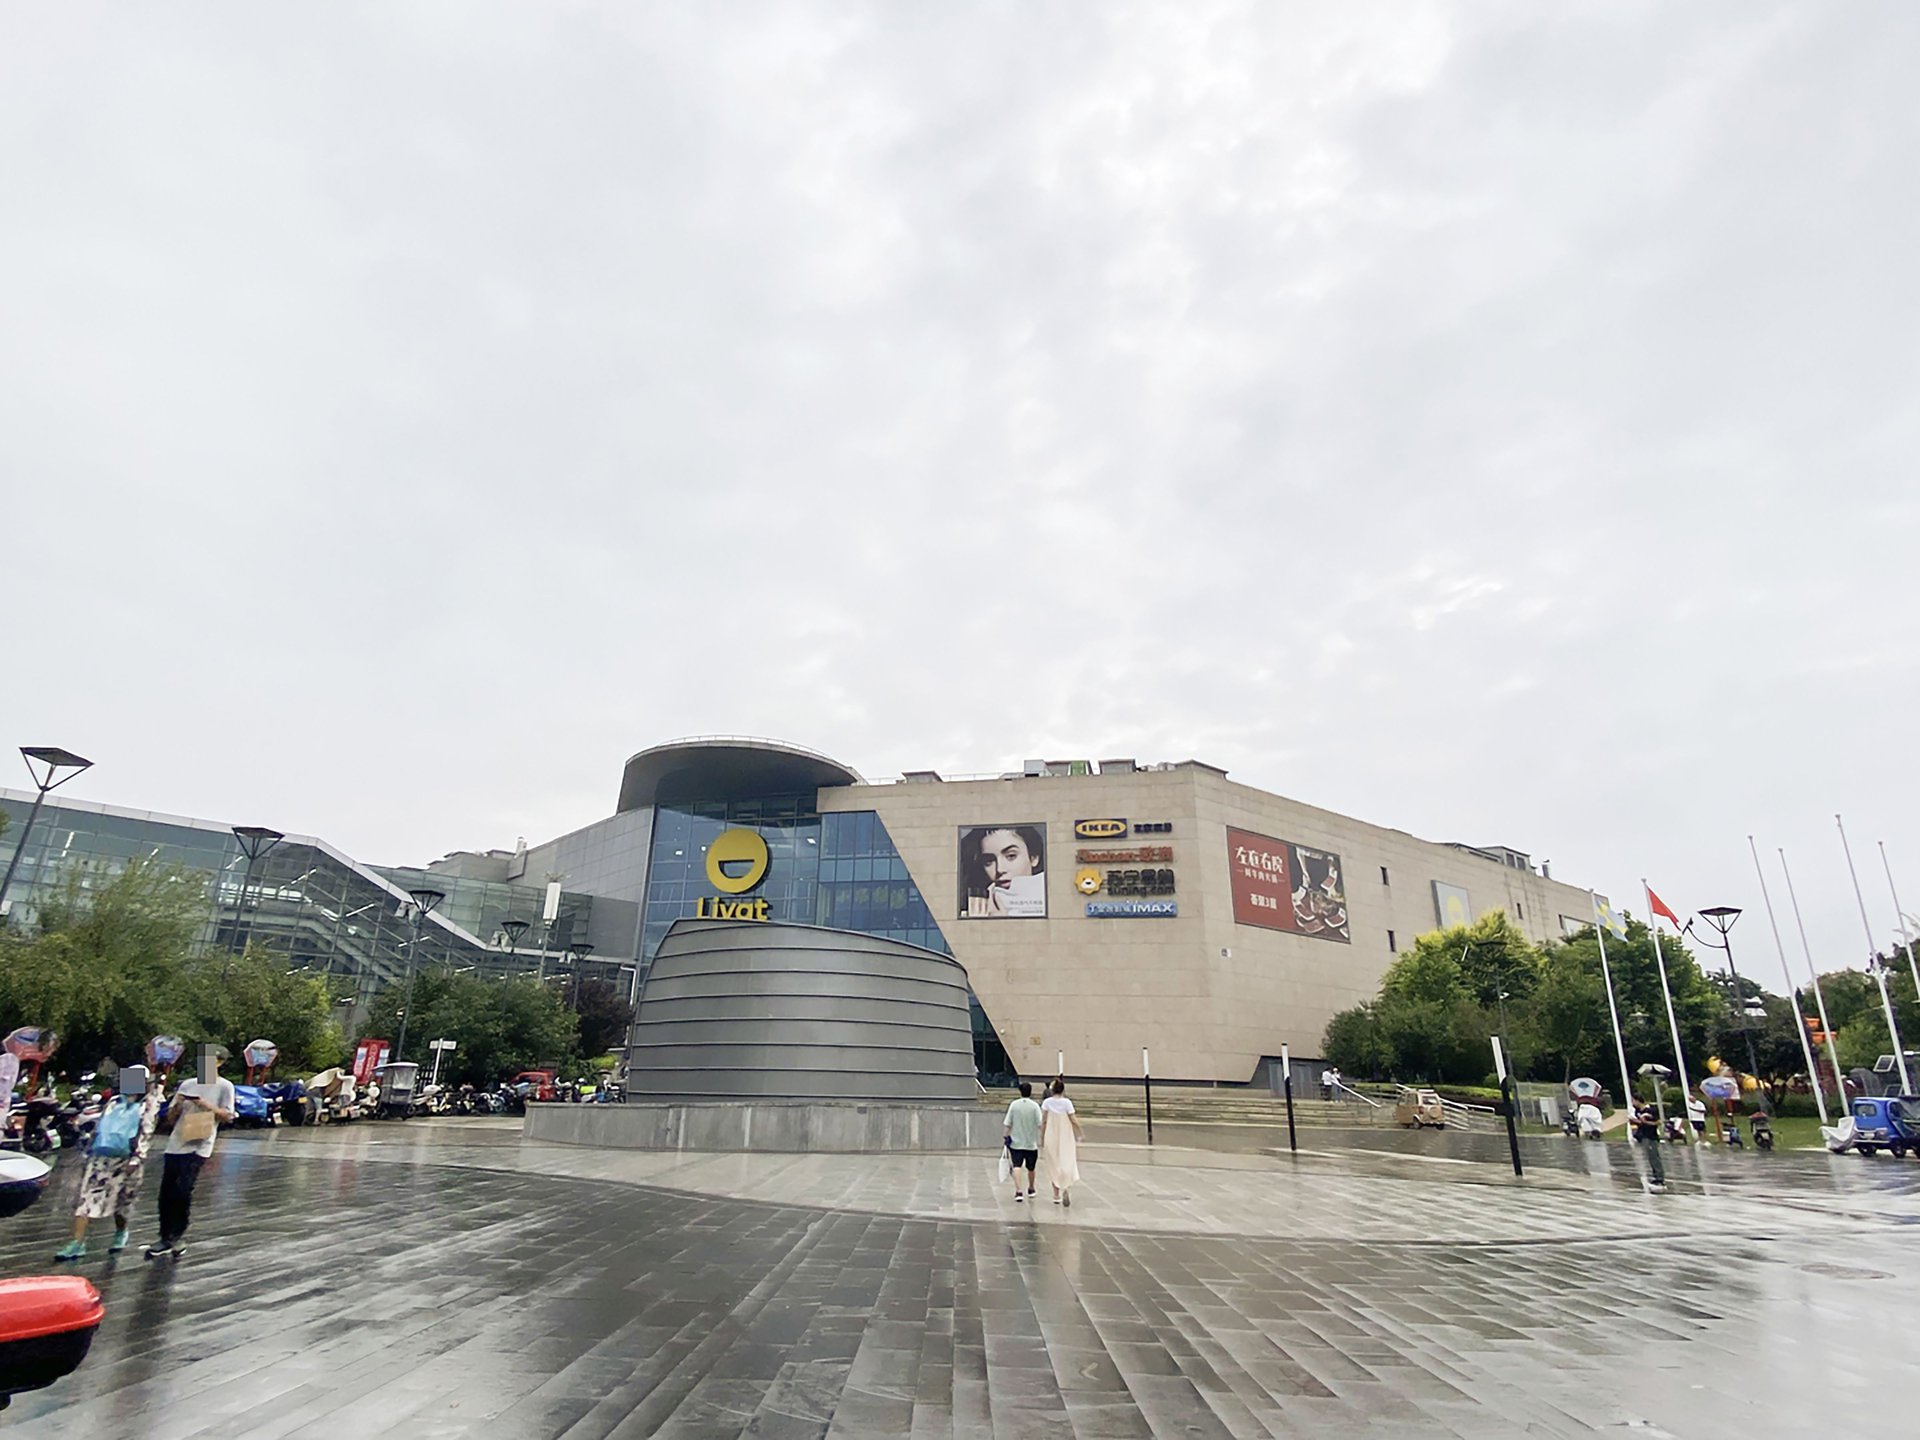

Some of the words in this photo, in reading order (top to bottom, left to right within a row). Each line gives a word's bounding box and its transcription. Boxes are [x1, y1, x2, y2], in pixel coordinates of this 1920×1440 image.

[1082, 823, 1121, 831] IKEA
[1107, 886, 1175, 898] suning.com
[697, 897, 768, 922] Livat
[1133, 904, 1173, 912] IMAX
